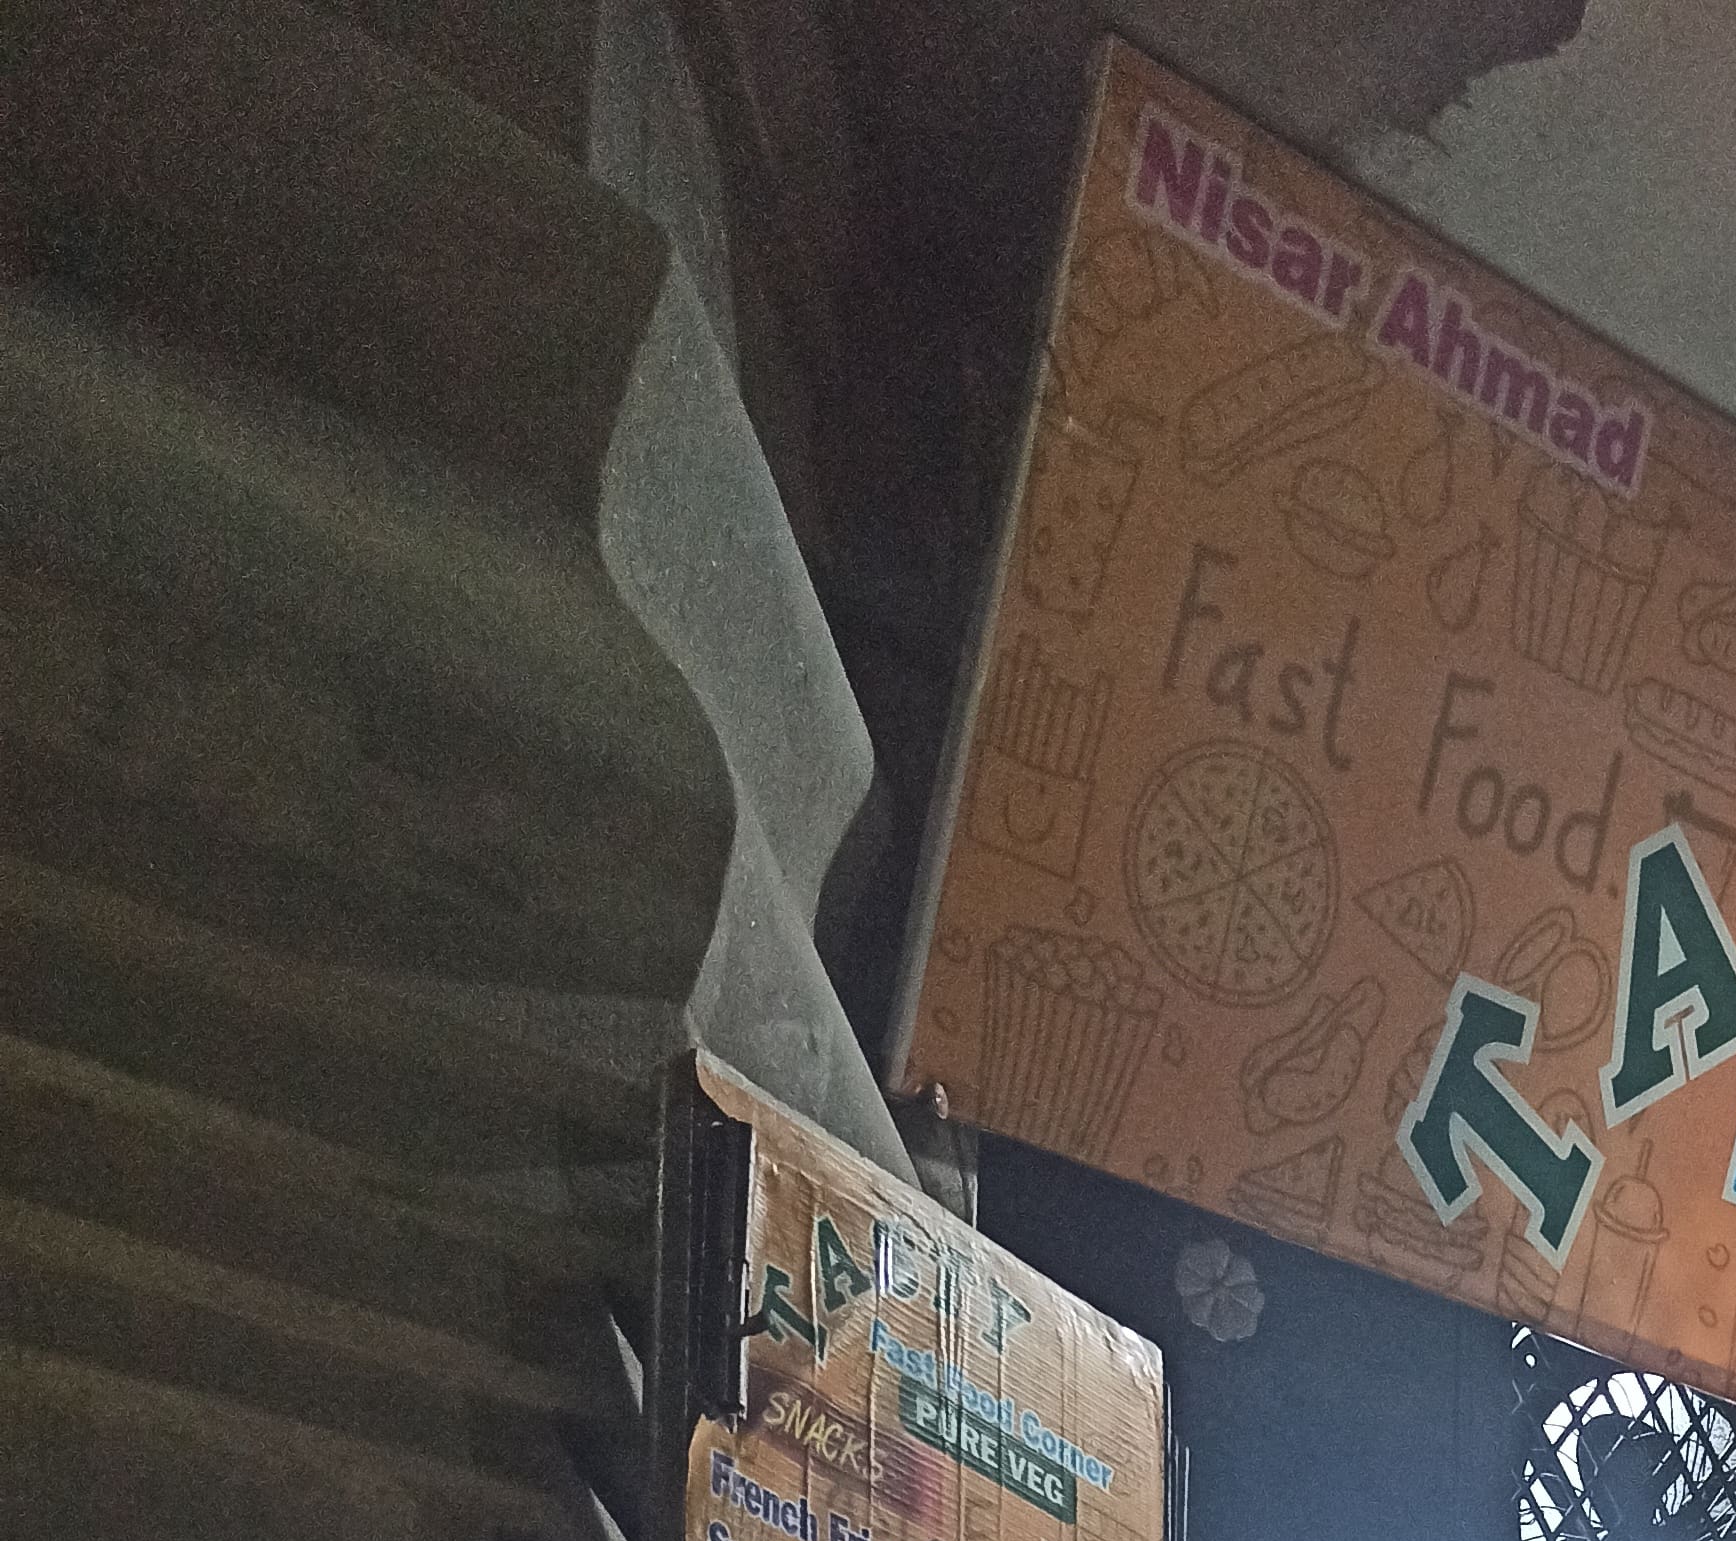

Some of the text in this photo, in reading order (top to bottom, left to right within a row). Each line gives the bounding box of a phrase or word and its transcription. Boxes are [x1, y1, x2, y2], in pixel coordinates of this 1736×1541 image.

[1130, 106, 1653, 499] Nisar Ahmad
[1160, 541, 1361, 774] Fast
[870, 1316, 938, 1391] Fast
[1019, 1408, 1115, 1492] Corner
[914, 1394, 1066, 1508] PURE VEG
